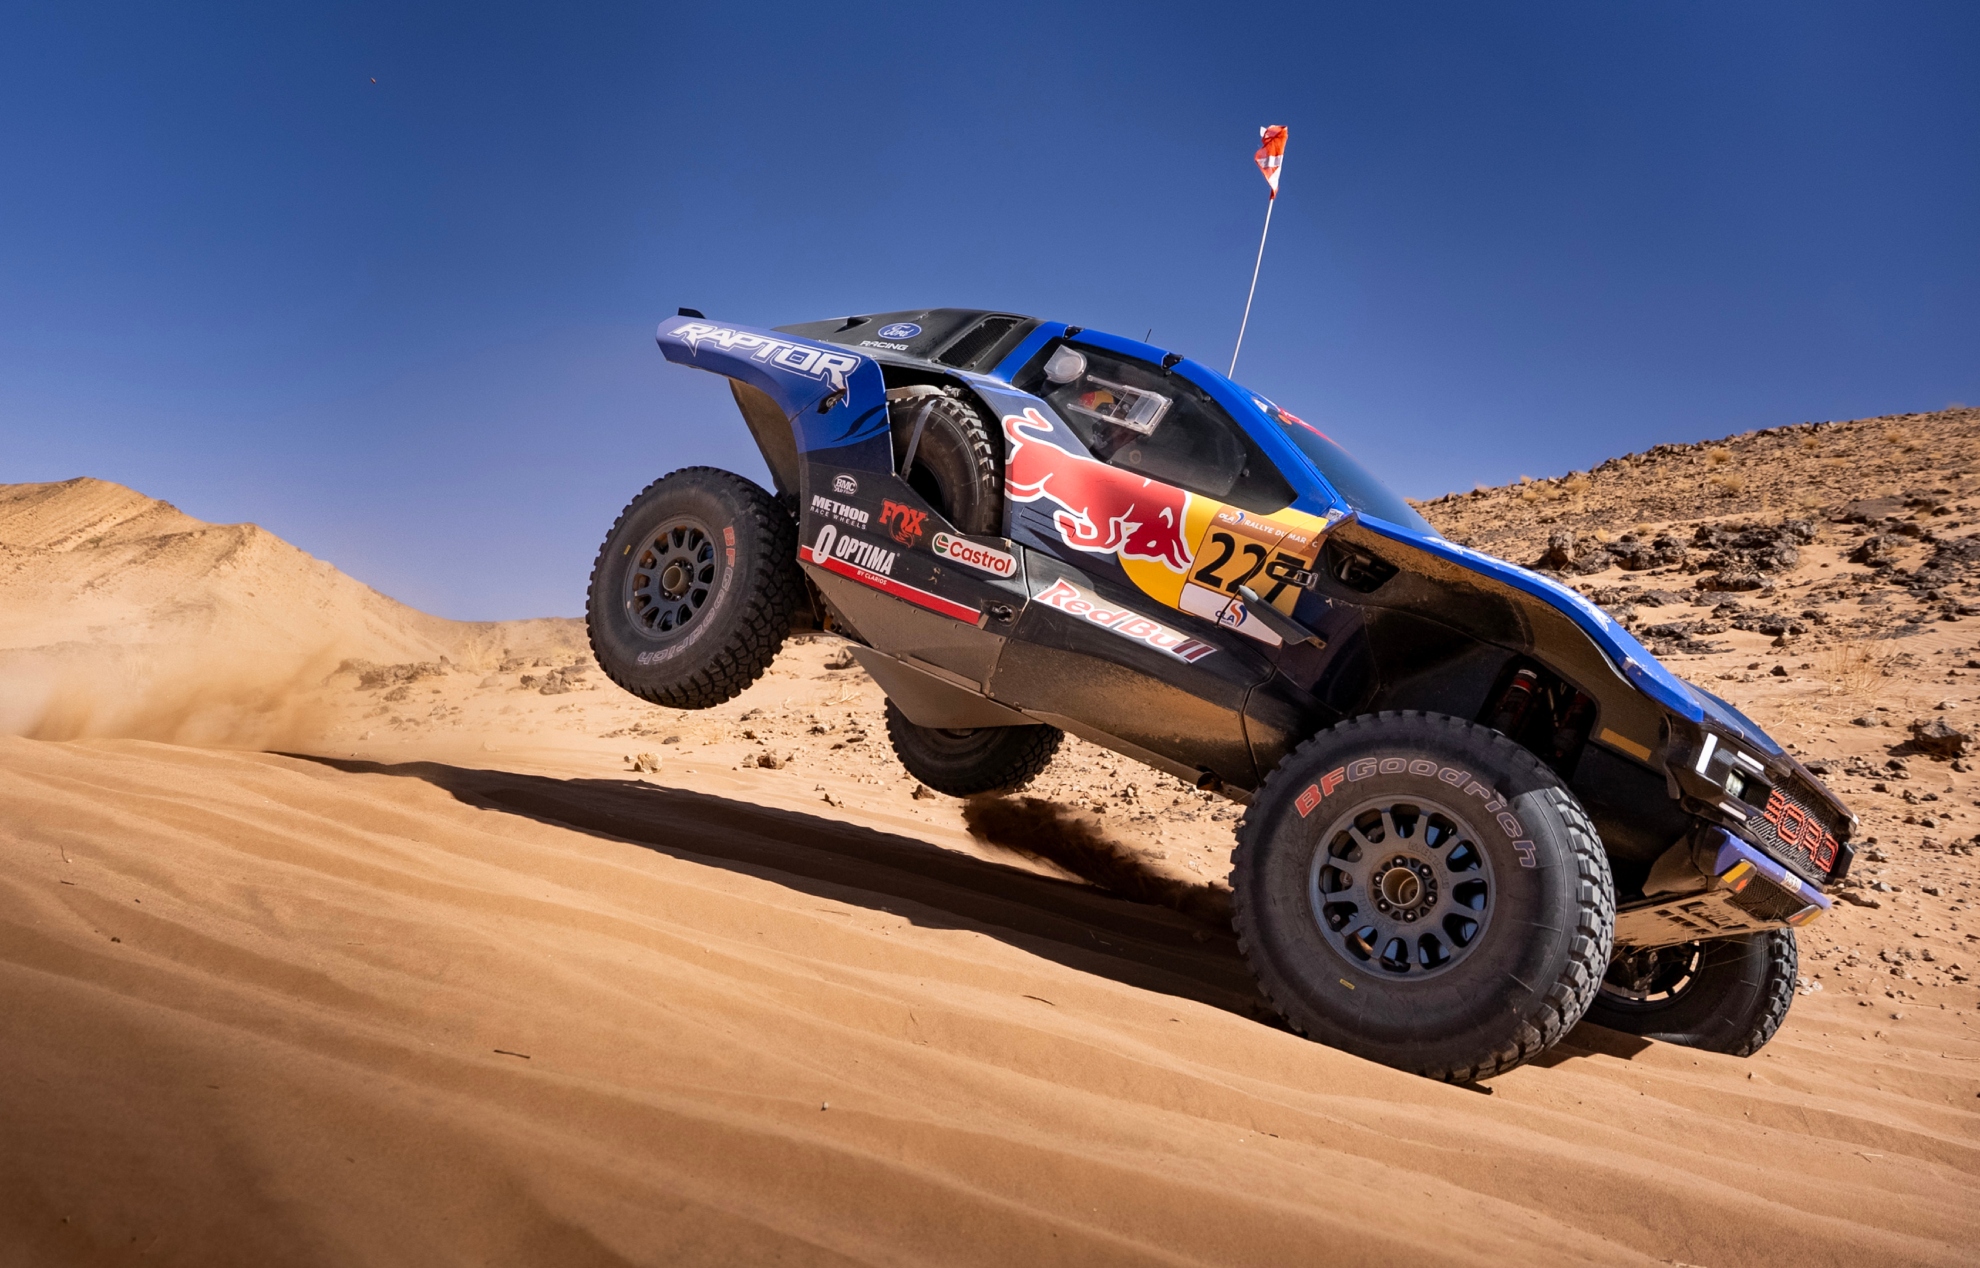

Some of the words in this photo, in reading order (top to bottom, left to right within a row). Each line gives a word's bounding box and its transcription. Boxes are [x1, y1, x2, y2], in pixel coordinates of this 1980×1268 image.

[860, 340, 909, 351] RACING
[883, 324, 915, 337] Ford
[669, 322, 860, 392] RAPTOR
[835, 478, 856, 491] BMC
[810, 506, 829, 517] RACE
[833, 514, 866, 530] WHEELS
[812, 495, 869, 524] METHOD
[879, 499, 928, 541] FOX
[1218, 513, 1235, 522] OLA
[1244, 520, 1275, 534] RALLYE
[1275, 530, 1287, 538] DU
[1287, 533, 1318, 548] MARC
[835, 535, 896, 575] OPTIMA
[950, 541, 1012, 574] Castrol
[1194, 532, 1306, 604] 227
[637, 526, 737, 665] BFGoodrich
[865, 572, 888, 586] CLARIOS
[1294, 757, 1538, 868] BFGoodrich
